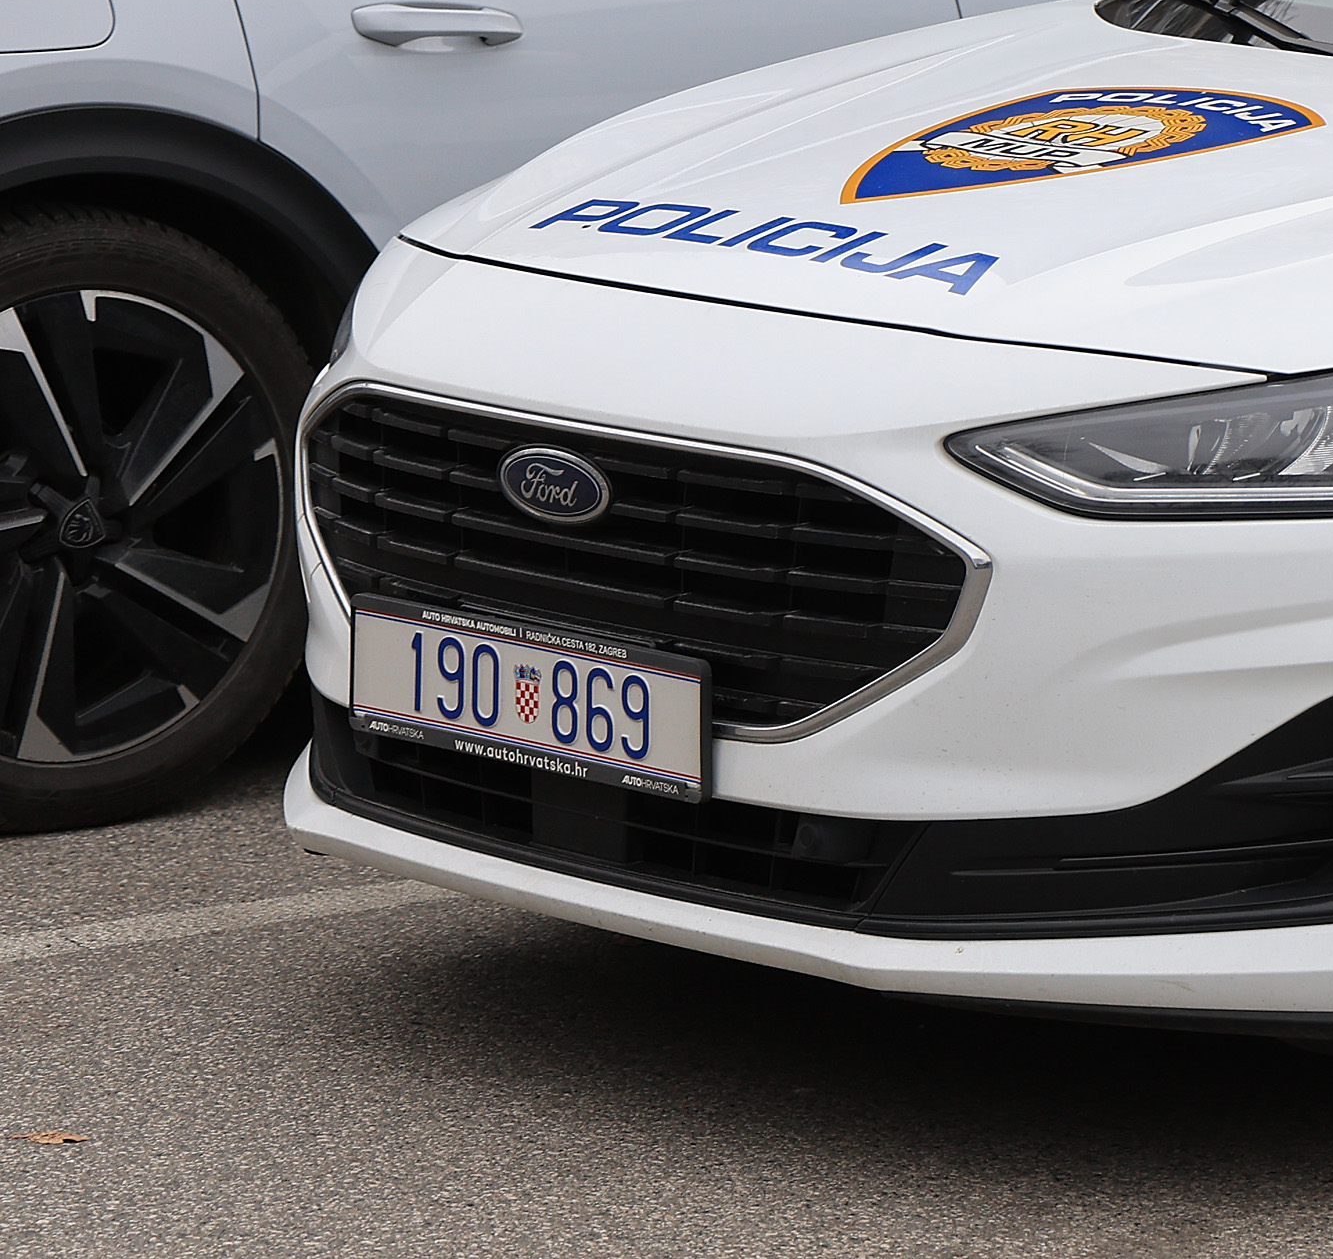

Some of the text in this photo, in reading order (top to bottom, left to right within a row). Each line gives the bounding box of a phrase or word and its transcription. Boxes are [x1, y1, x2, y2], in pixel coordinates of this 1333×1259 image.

[1008, 118, 1147, 148] RH
[1049, 92, 1297, 134] POLICIJA
[966, 137, 1080, 160] MUP
[529, 199, 1000, 296] POLICIJA
[520, 462, 579, 507] Ford
[421, 610, 441, 621] AUTO
[441, 614, 476, 629] HRVATSKA
[476, 621, 517, 637] AUTOMOBILI
[562, 637, 585, 650] CESTA
[598, 644, 628, 659] ZAGREB
[411, 631, 651, 760] 190 869
[369, 720, 425, 740] AUTOHRVATSKA
[454, 739, 589, 778] www.autohrvatska.hr
[621, 774, 680, 795] AUTOHRVATSKA
